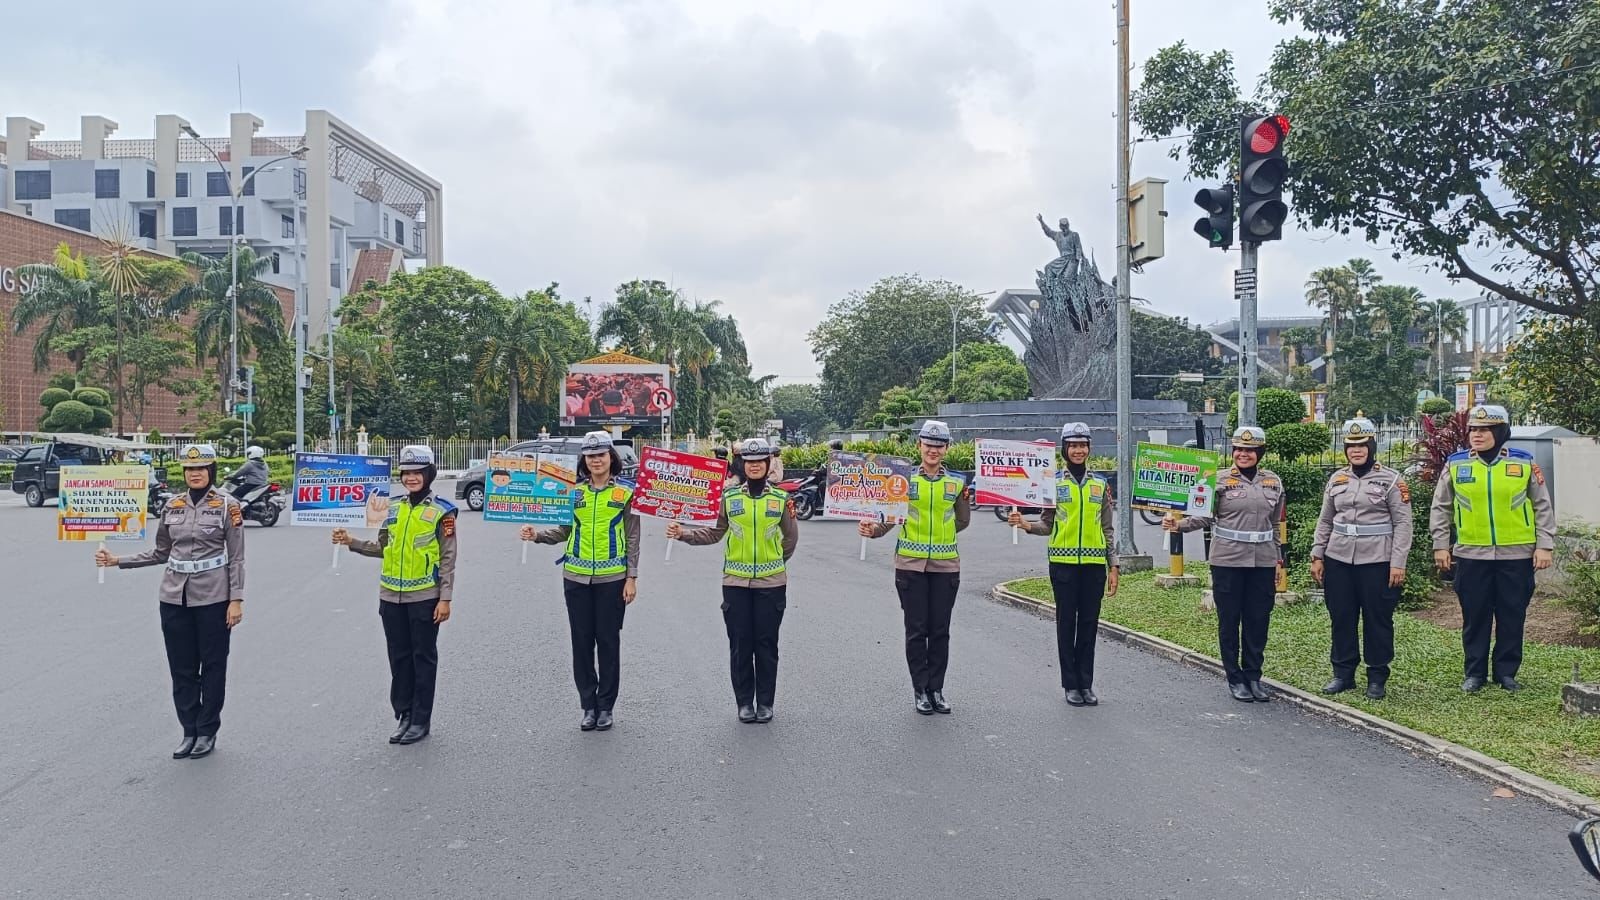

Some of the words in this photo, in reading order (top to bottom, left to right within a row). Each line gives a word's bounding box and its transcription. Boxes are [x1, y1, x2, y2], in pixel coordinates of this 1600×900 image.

[646, 459, 693, 476] GOLPUT
[865, 462, 892, 474] Riau
[980, 456, 1004, 465] YOK
[1008, 457, 1023, 466] KE
[1027, 458, 1049, 467] TPS
[982, 466, 993, 476] 14
[1139, 469, 1162, 482] KITA
[1165, 471, 1176, 484] KE
[1179, 473, 1195, 486] TPS
[64, 480, 89, 488] JANGAN
[91, 480, 114, 488] SAMPAI
[659, 473, 691, 485] BUDAYA
[692, 480, 709, 488] KITE
[840, 474, 855, 486] Tak
[854, 473, 882, 487] Akan
[298, 486, 321, 502] KE
[328, 485, 364, 502] TPS
[666, 482, 708, 497] SAUDARE
[830, 486, 861, 501] Golput
